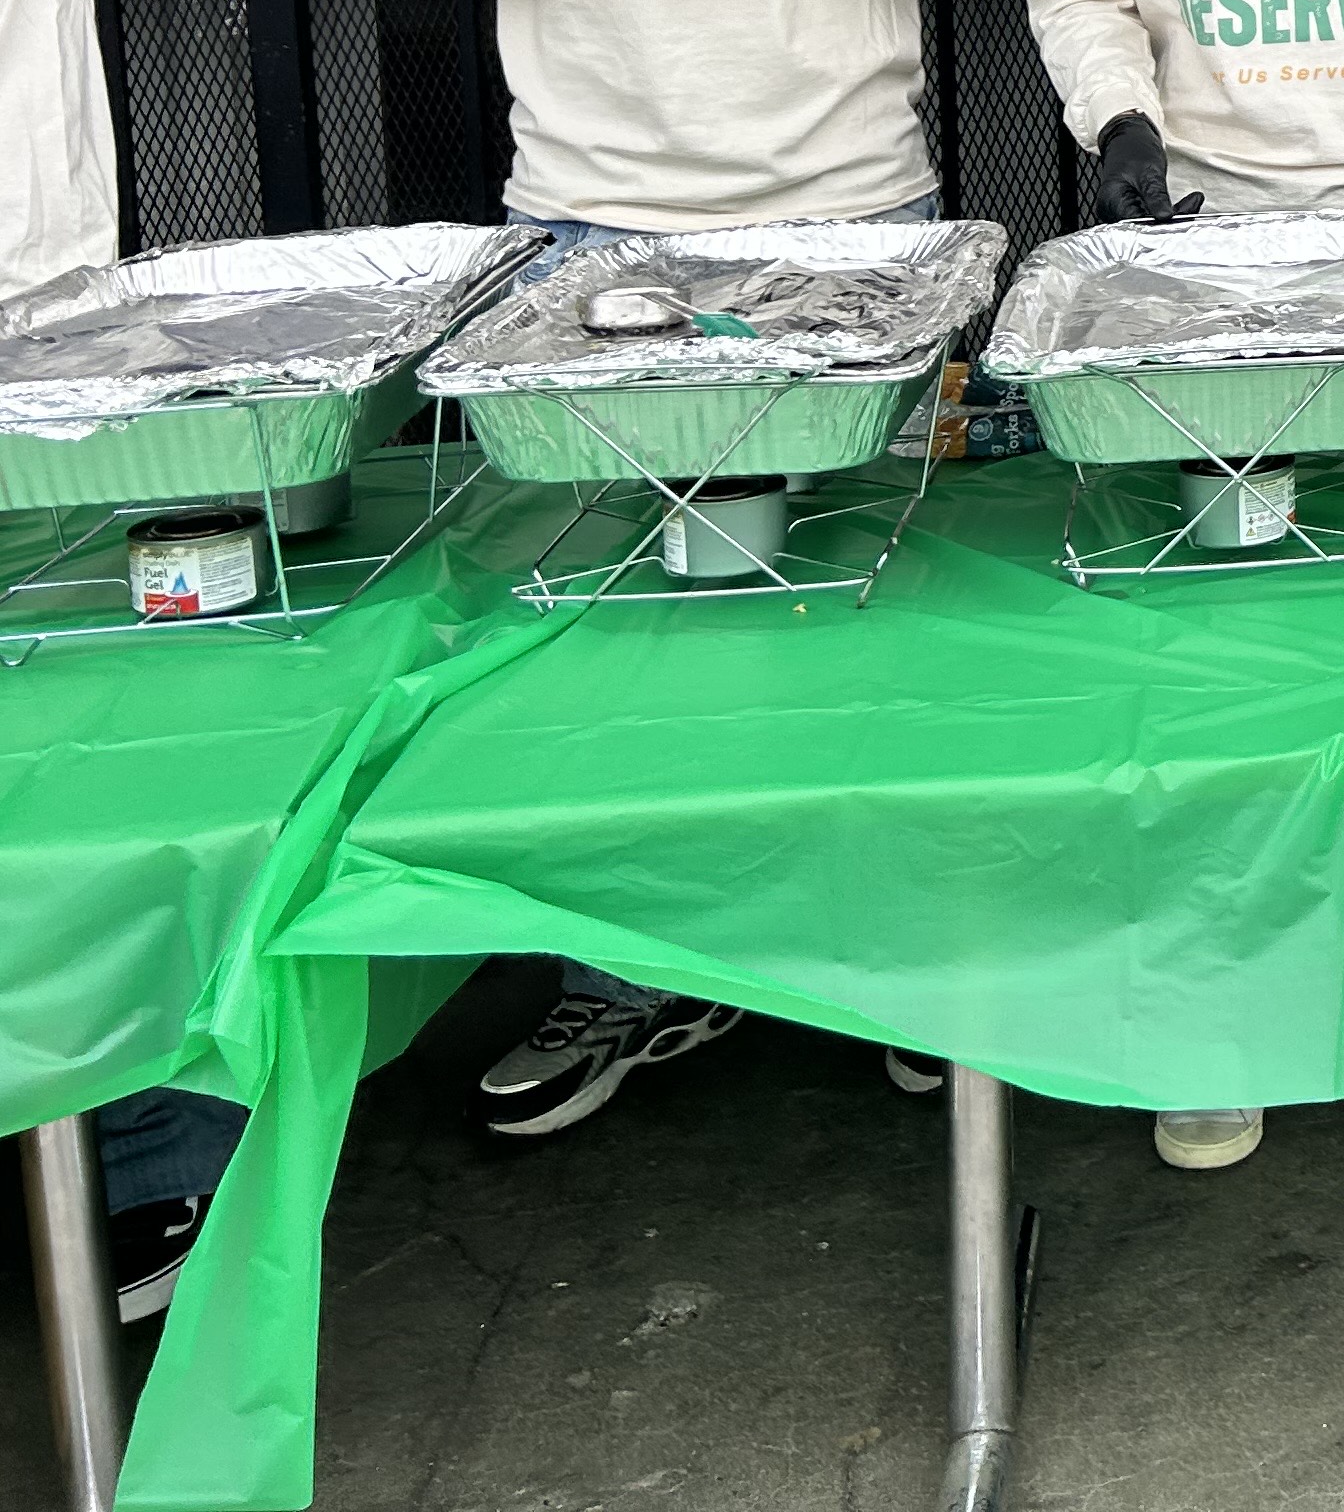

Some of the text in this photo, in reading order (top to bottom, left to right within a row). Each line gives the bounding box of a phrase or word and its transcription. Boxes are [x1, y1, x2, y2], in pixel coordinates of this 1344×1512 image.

[1238, 68, 1268, 85] Us
[144, 567, 169, 578] Fuel
[145, 579, 165, 591] Gel
